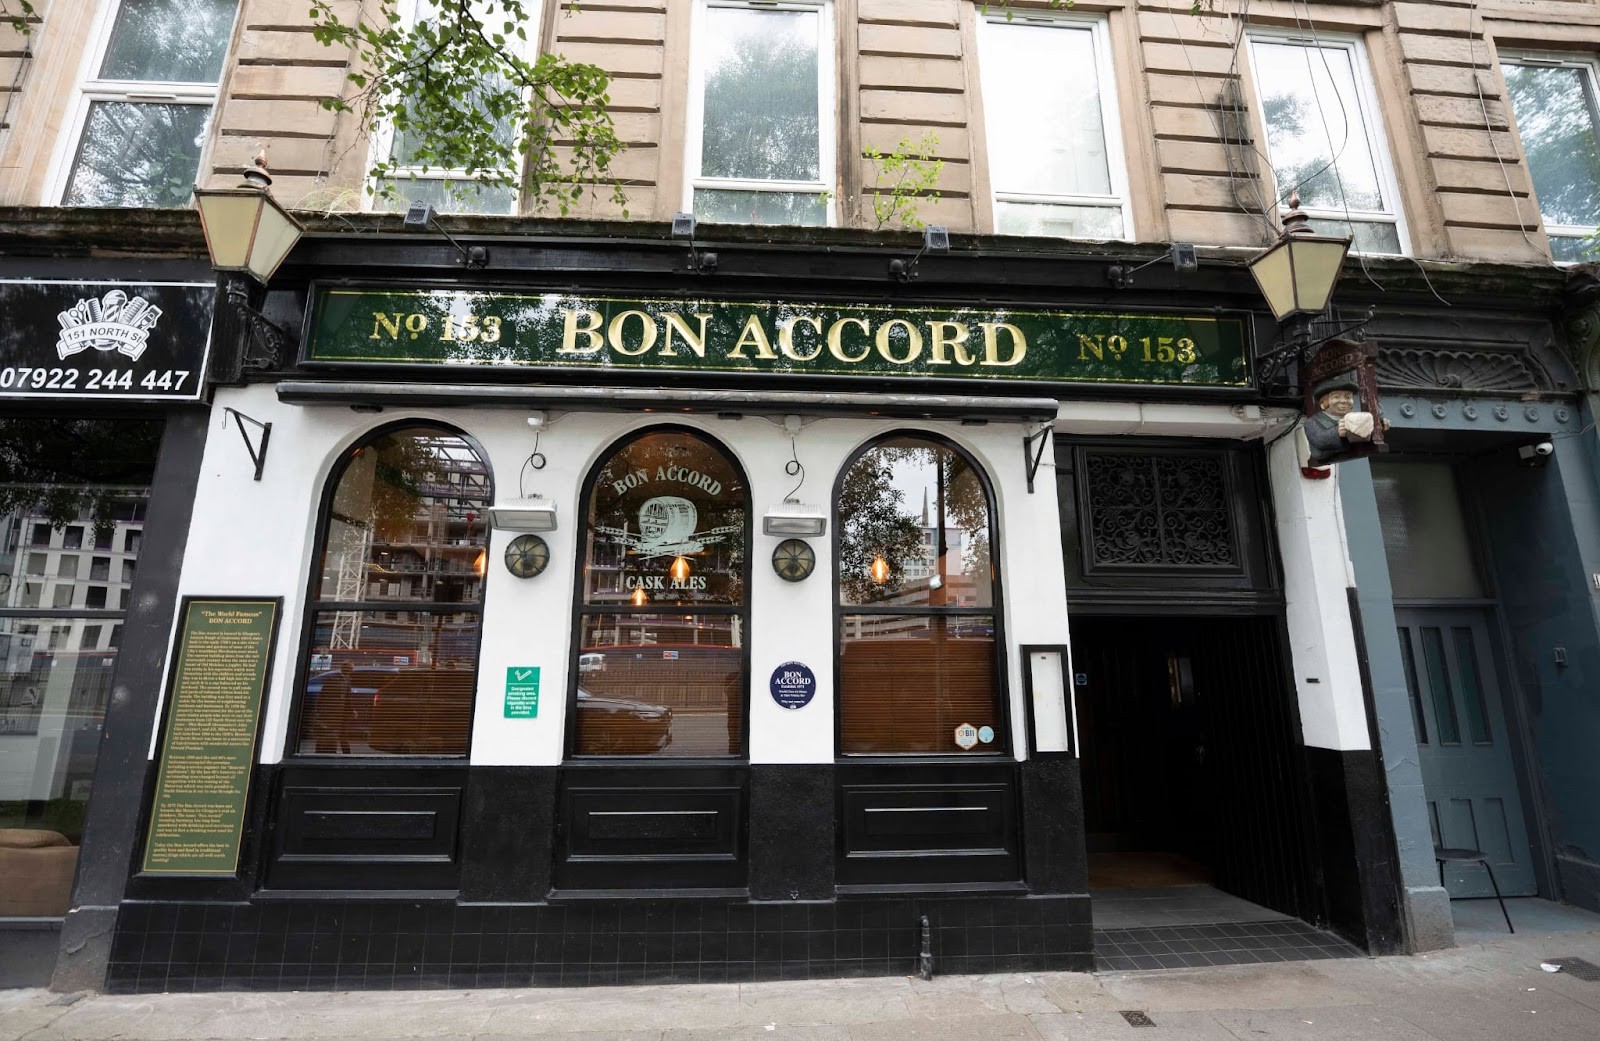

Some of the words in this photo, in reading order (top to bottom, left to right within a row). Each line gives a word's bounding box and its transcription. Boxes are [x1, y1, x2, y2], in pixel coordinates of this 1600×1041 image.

[66, 330, 86, 341] 151
[90, 327, 128, 338] NORTH
[440, 314, 502, 342] 153
[555, 307, 713, 358] BON
[727, 313, 1027, 367] ACCORD
[1139, 336, 1198, 364] 153
[1312, 353, 1353, 377] ACCORD
[0, 367, 79, 390] 07922
[85, 369, 133, 390] 244
[140, 370, 190, 390] 447
[612, 468, 649, 496] BON
[655, 465, 722, 497] ACCORD
[626, 575, 664, 590] CASK
[670, 576, 707, 590] ALES
